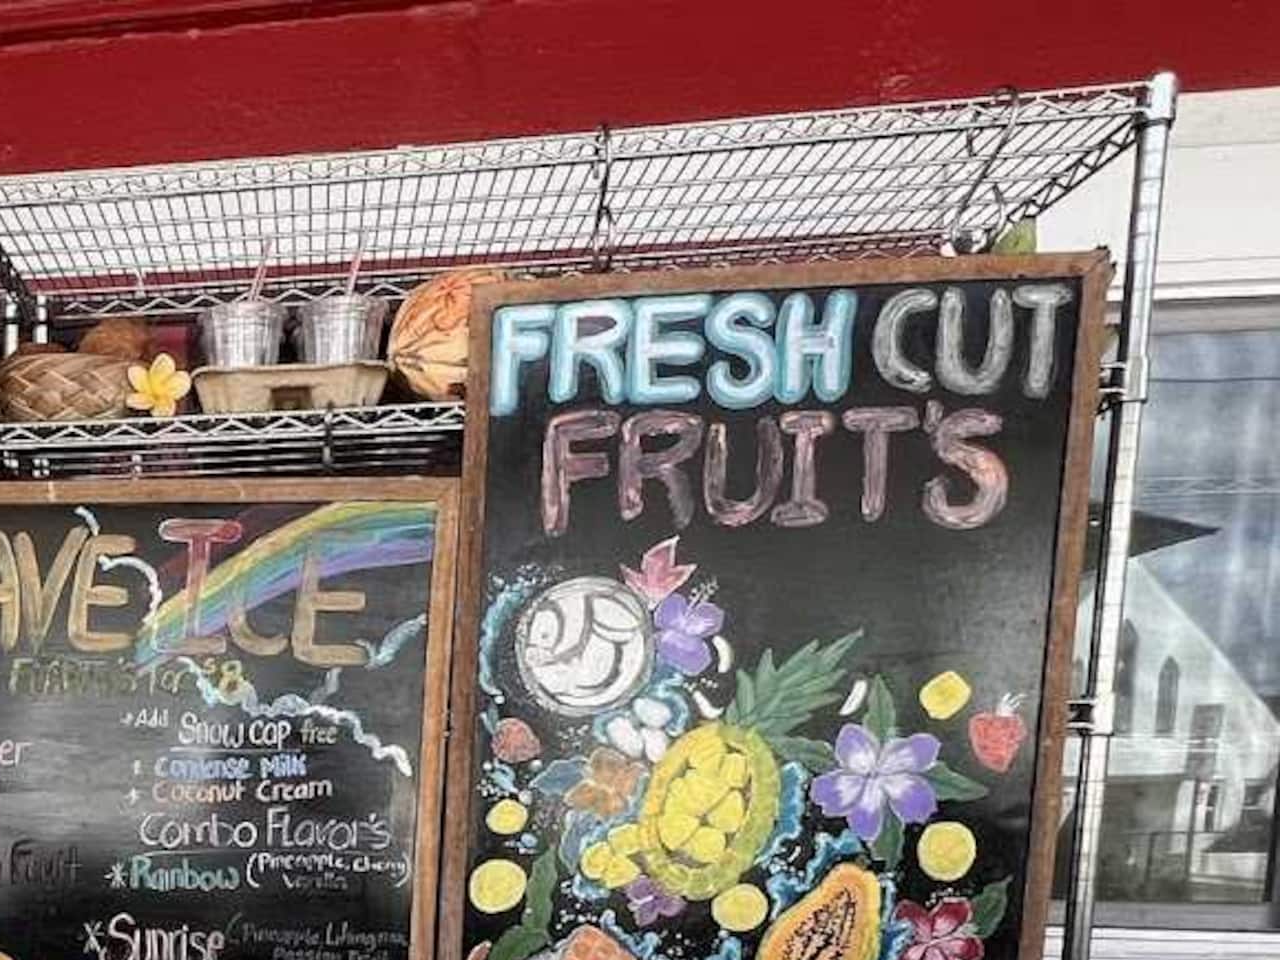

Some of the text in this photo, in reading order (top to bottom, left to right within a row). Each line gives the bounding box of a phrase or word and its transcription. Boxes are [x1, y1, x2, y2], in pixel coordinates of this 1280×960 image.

[488, 283, 1074, 416] FRESH CUT
[541, 400, 1010, 538] FRUIT'S
[154, 517, 370, 667] ICE
[139, 812, 258, 848] Combo
[152, 779, 333, 804] Coconut Cream
[130, 854, 240, 892] Rainbow
